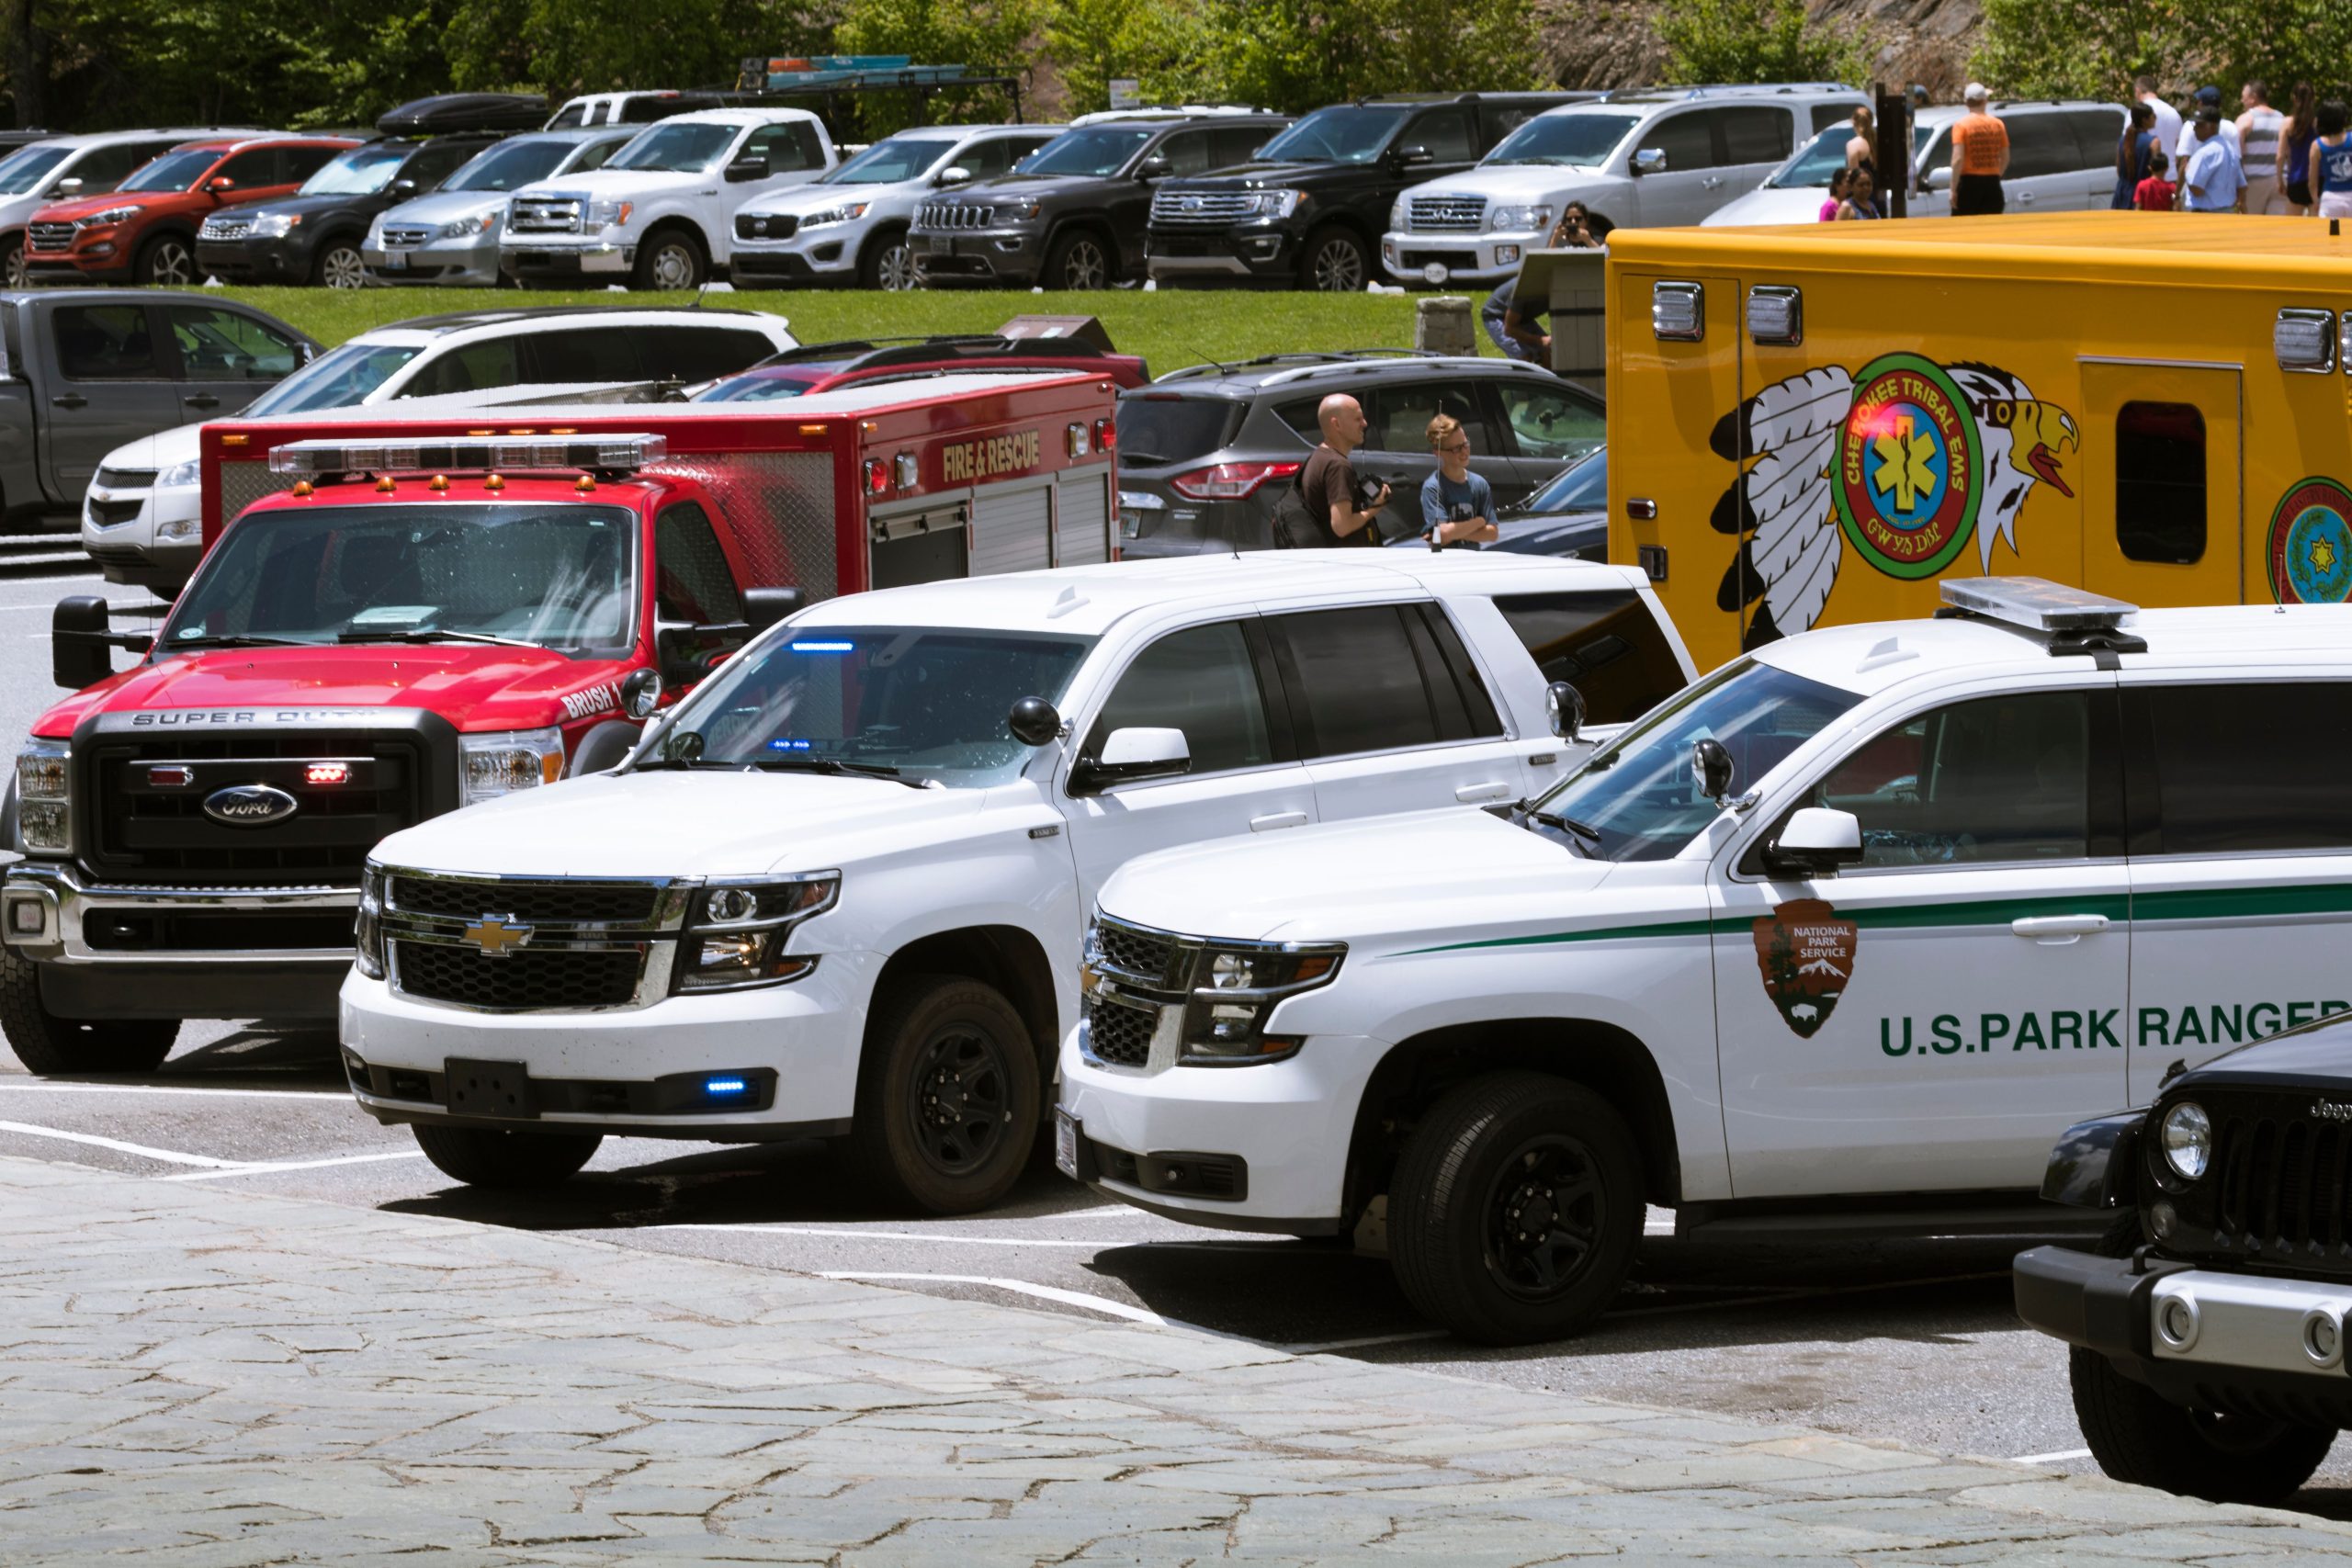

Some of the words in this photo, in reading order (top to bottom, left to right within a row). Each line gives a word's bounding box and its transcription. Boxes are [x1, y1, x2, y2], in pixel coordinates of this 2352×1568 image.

[1846, 378, 1899, 485] CHEROKEE
[1901, 377, 1955, 434] TRIBAL
[1949, 434, 1965, 493] EMS
[943, 442, 974, 483] FIRE
[976, 440, 986, 478] &
[987, 430, 1040, 474] RESCUE
[560, 683, 615, 719] BRUSH
[611, 681, 623, 704] 1
[131, 712, 256, 726] SUPER
[221, 791, 274, 816] Ford
[1793, 926, 1851, 937] NATIONAL
[1808, 937, 1838, 947] PARK
[1800, 947, 1847, 958] SERVICE
[2310, 1097, 2352, 1123] Jeep
